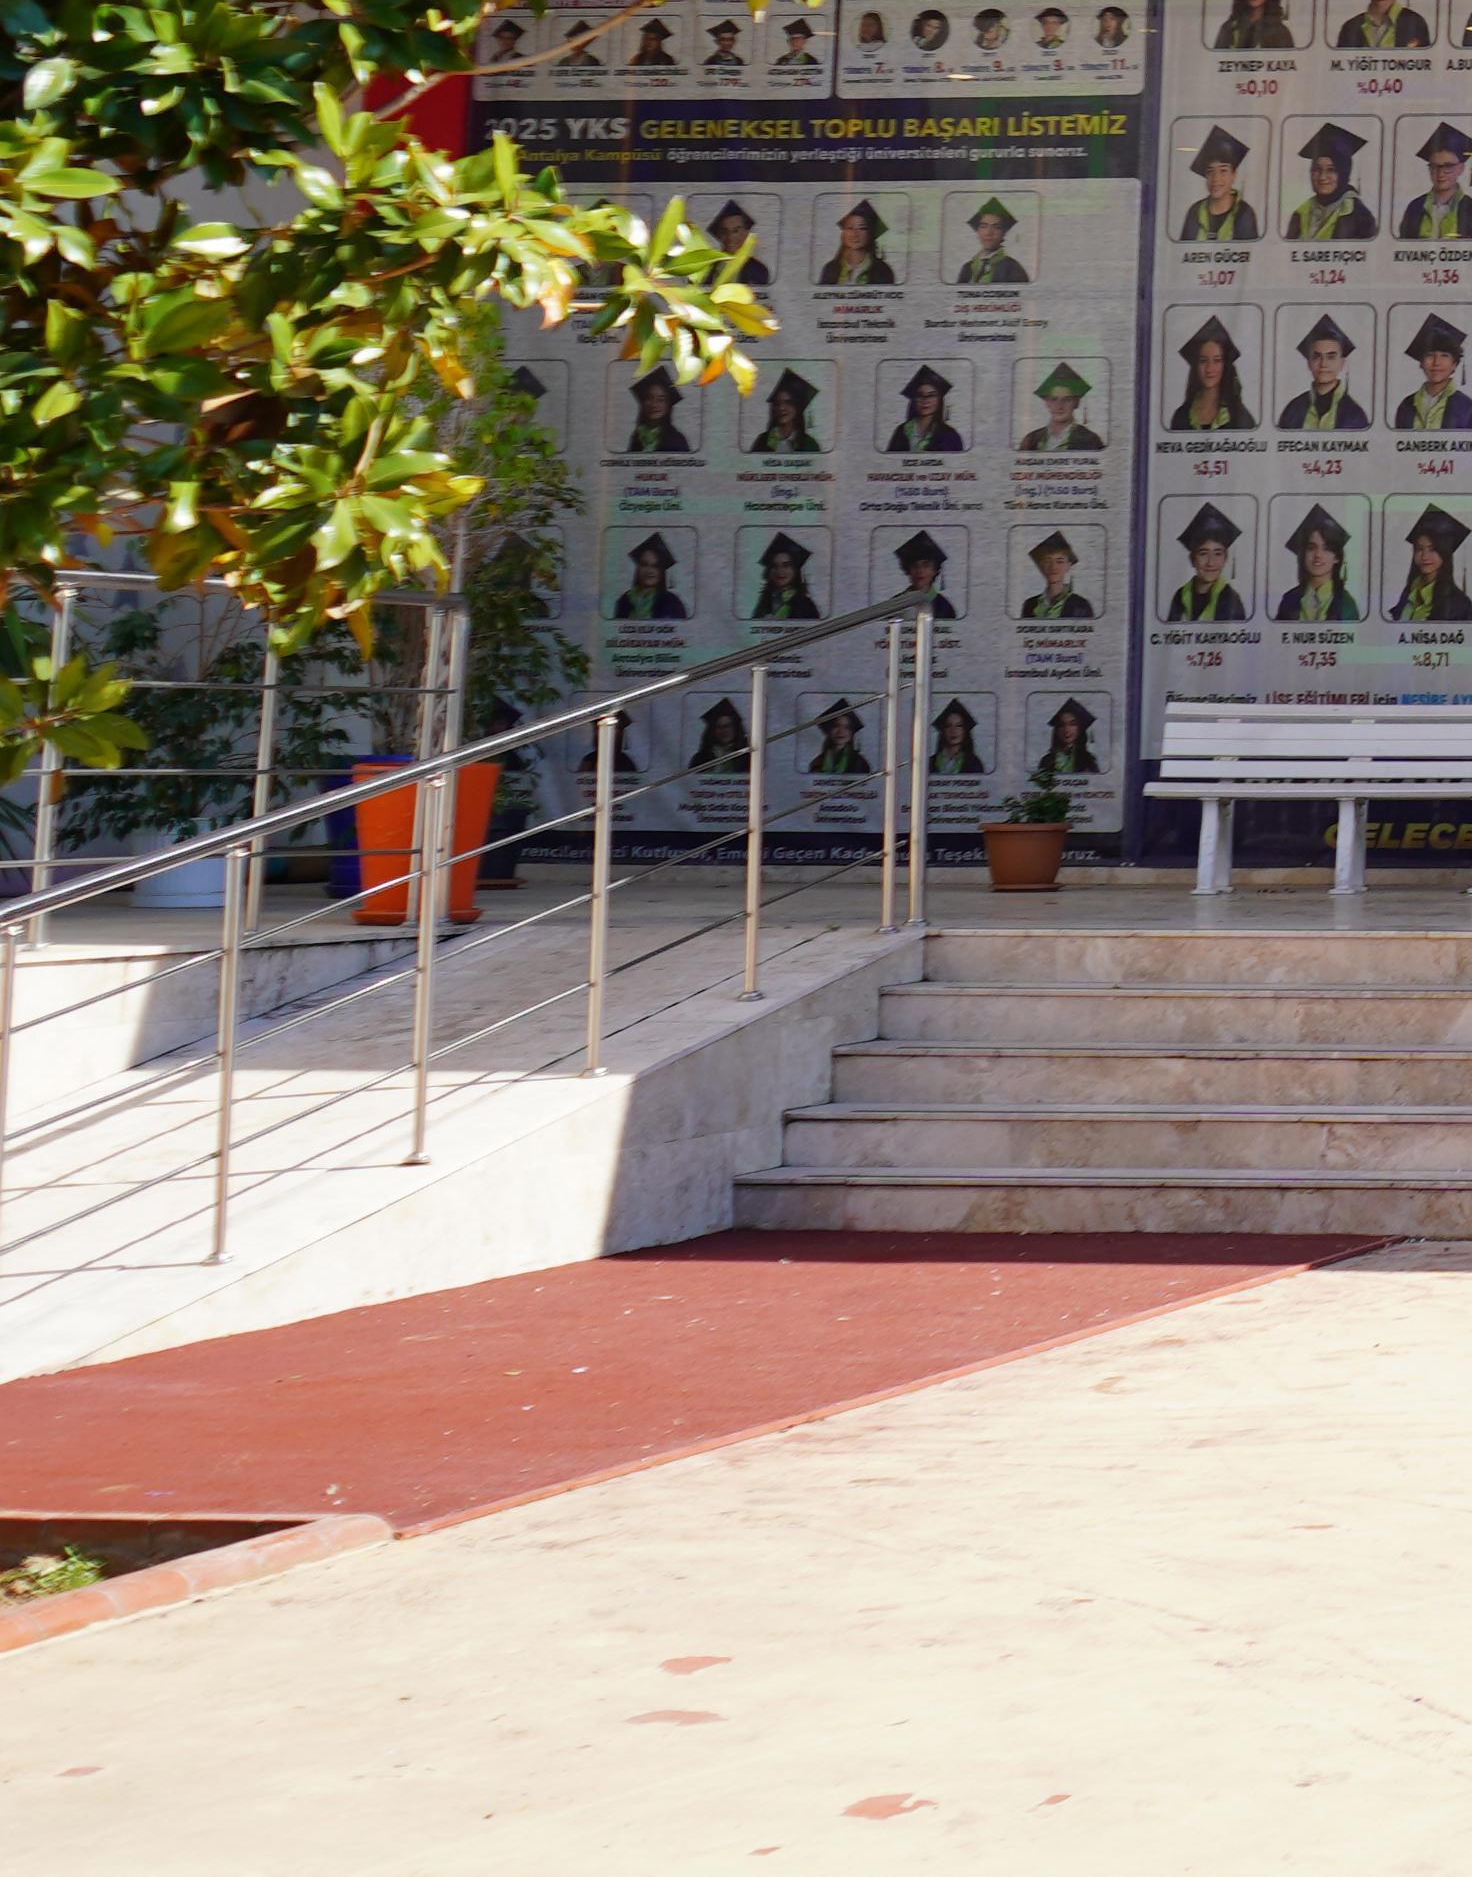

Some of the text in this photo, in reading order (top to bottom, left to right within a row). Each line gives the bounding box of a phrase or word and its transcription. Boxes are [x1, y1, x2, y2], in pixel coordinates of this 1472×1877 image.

[565, 117, 627, 140] YKS
[639, 119, 806, 139] GELENEKSEL
[809, 118, 897, 139] TOPLU
[902, 117, 1000, 142] BAŞARI
[1007, 109, 1128, 137] LİSTEMİZ
